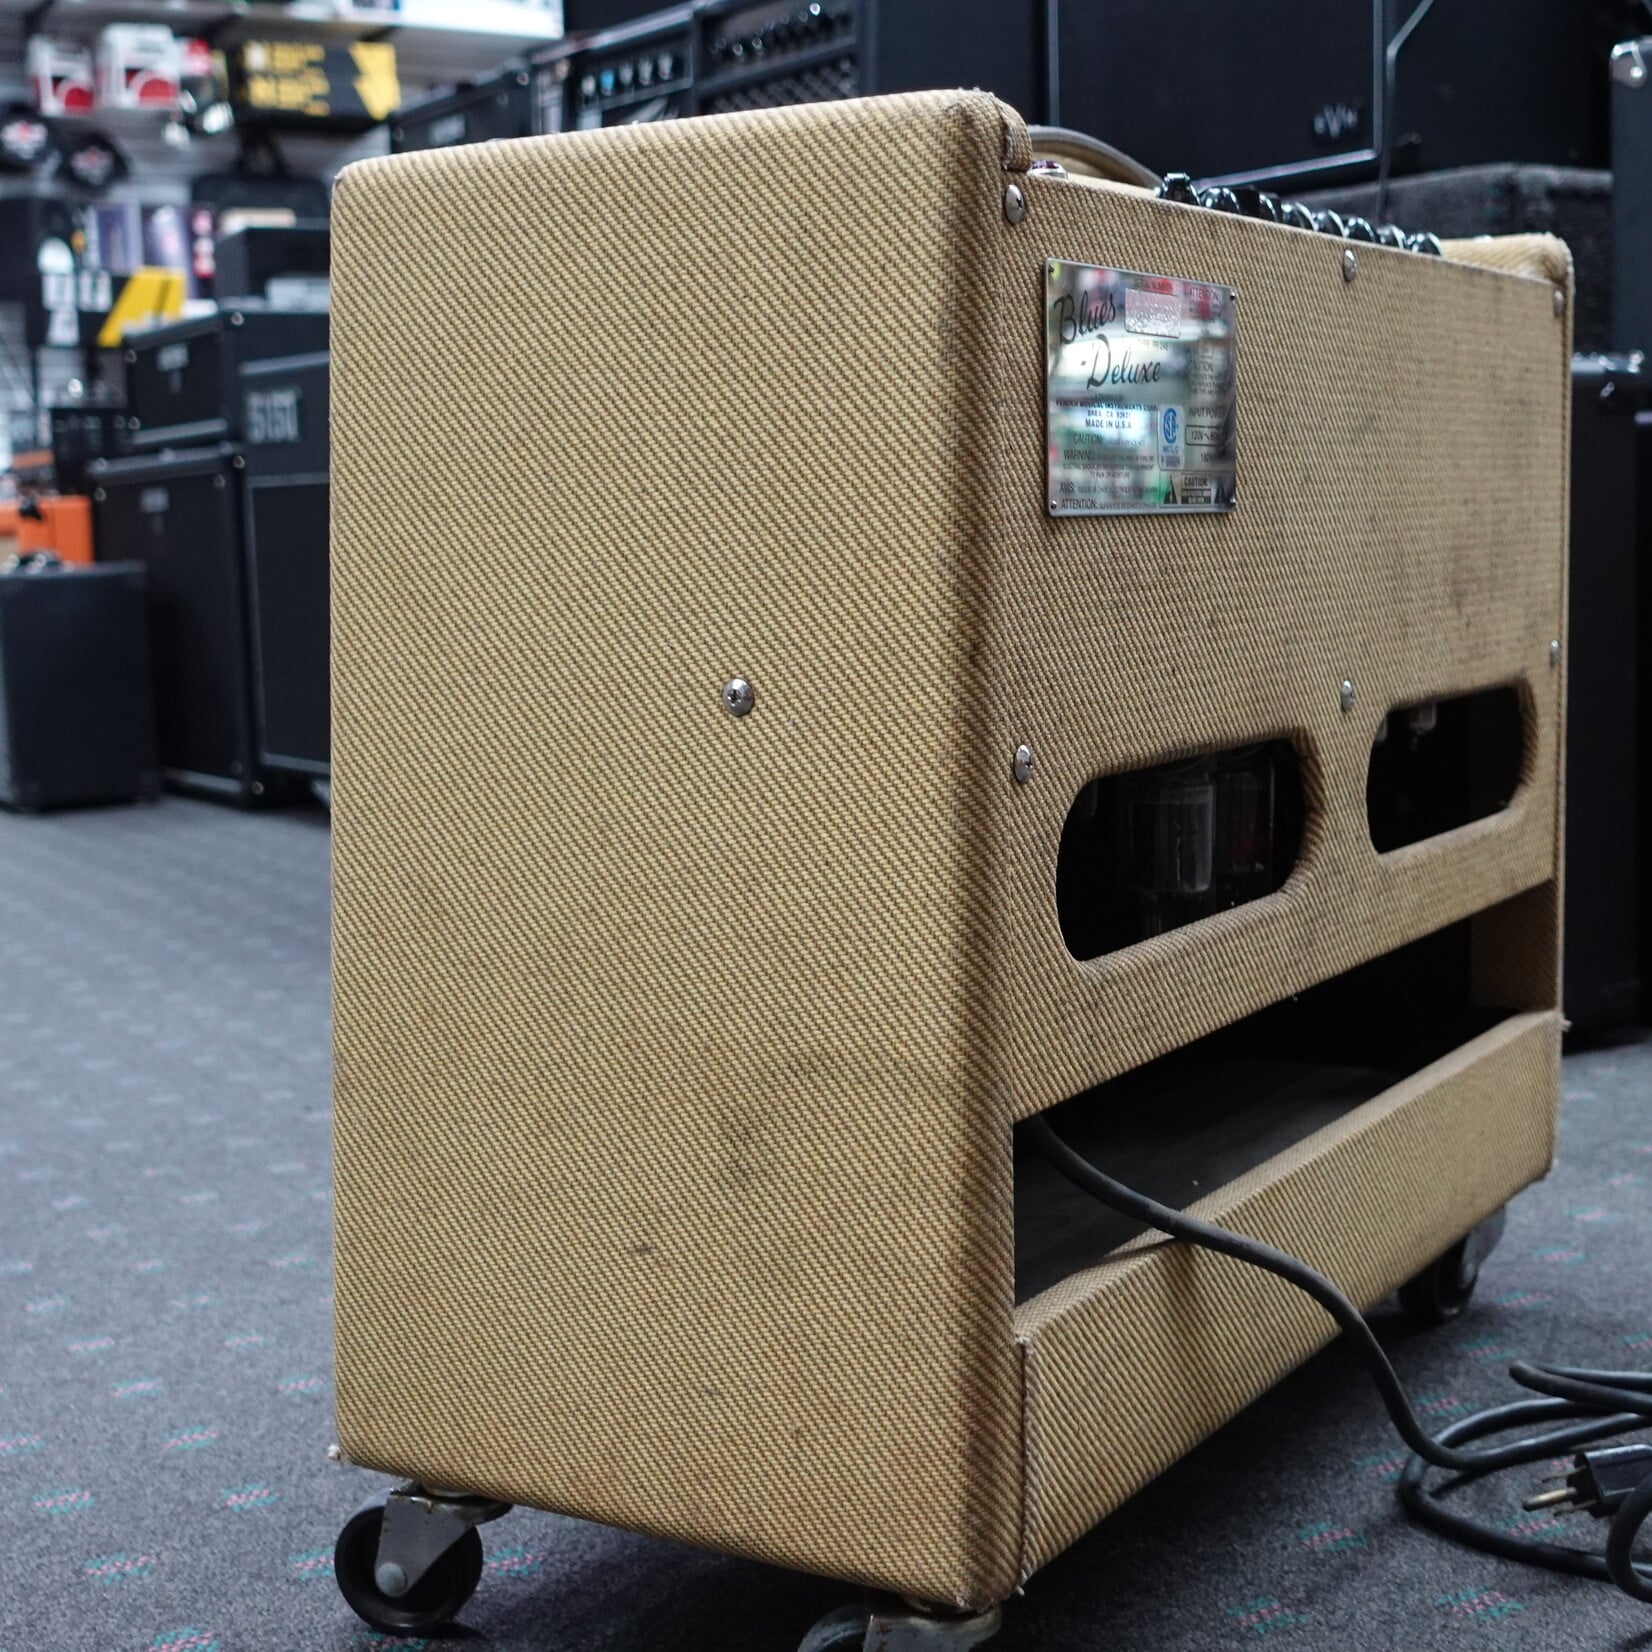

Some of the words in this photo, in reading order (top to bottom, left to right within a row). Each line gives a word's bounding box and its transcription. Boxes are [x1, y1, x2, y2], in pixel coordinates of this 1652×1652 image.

[1053, 290, 1117, 345] Blues
[1086, 333, 1161, 390] Deluxe
[1085, 418, 1104, 428] MADE
[1106, 420, 1113, 428] IN
